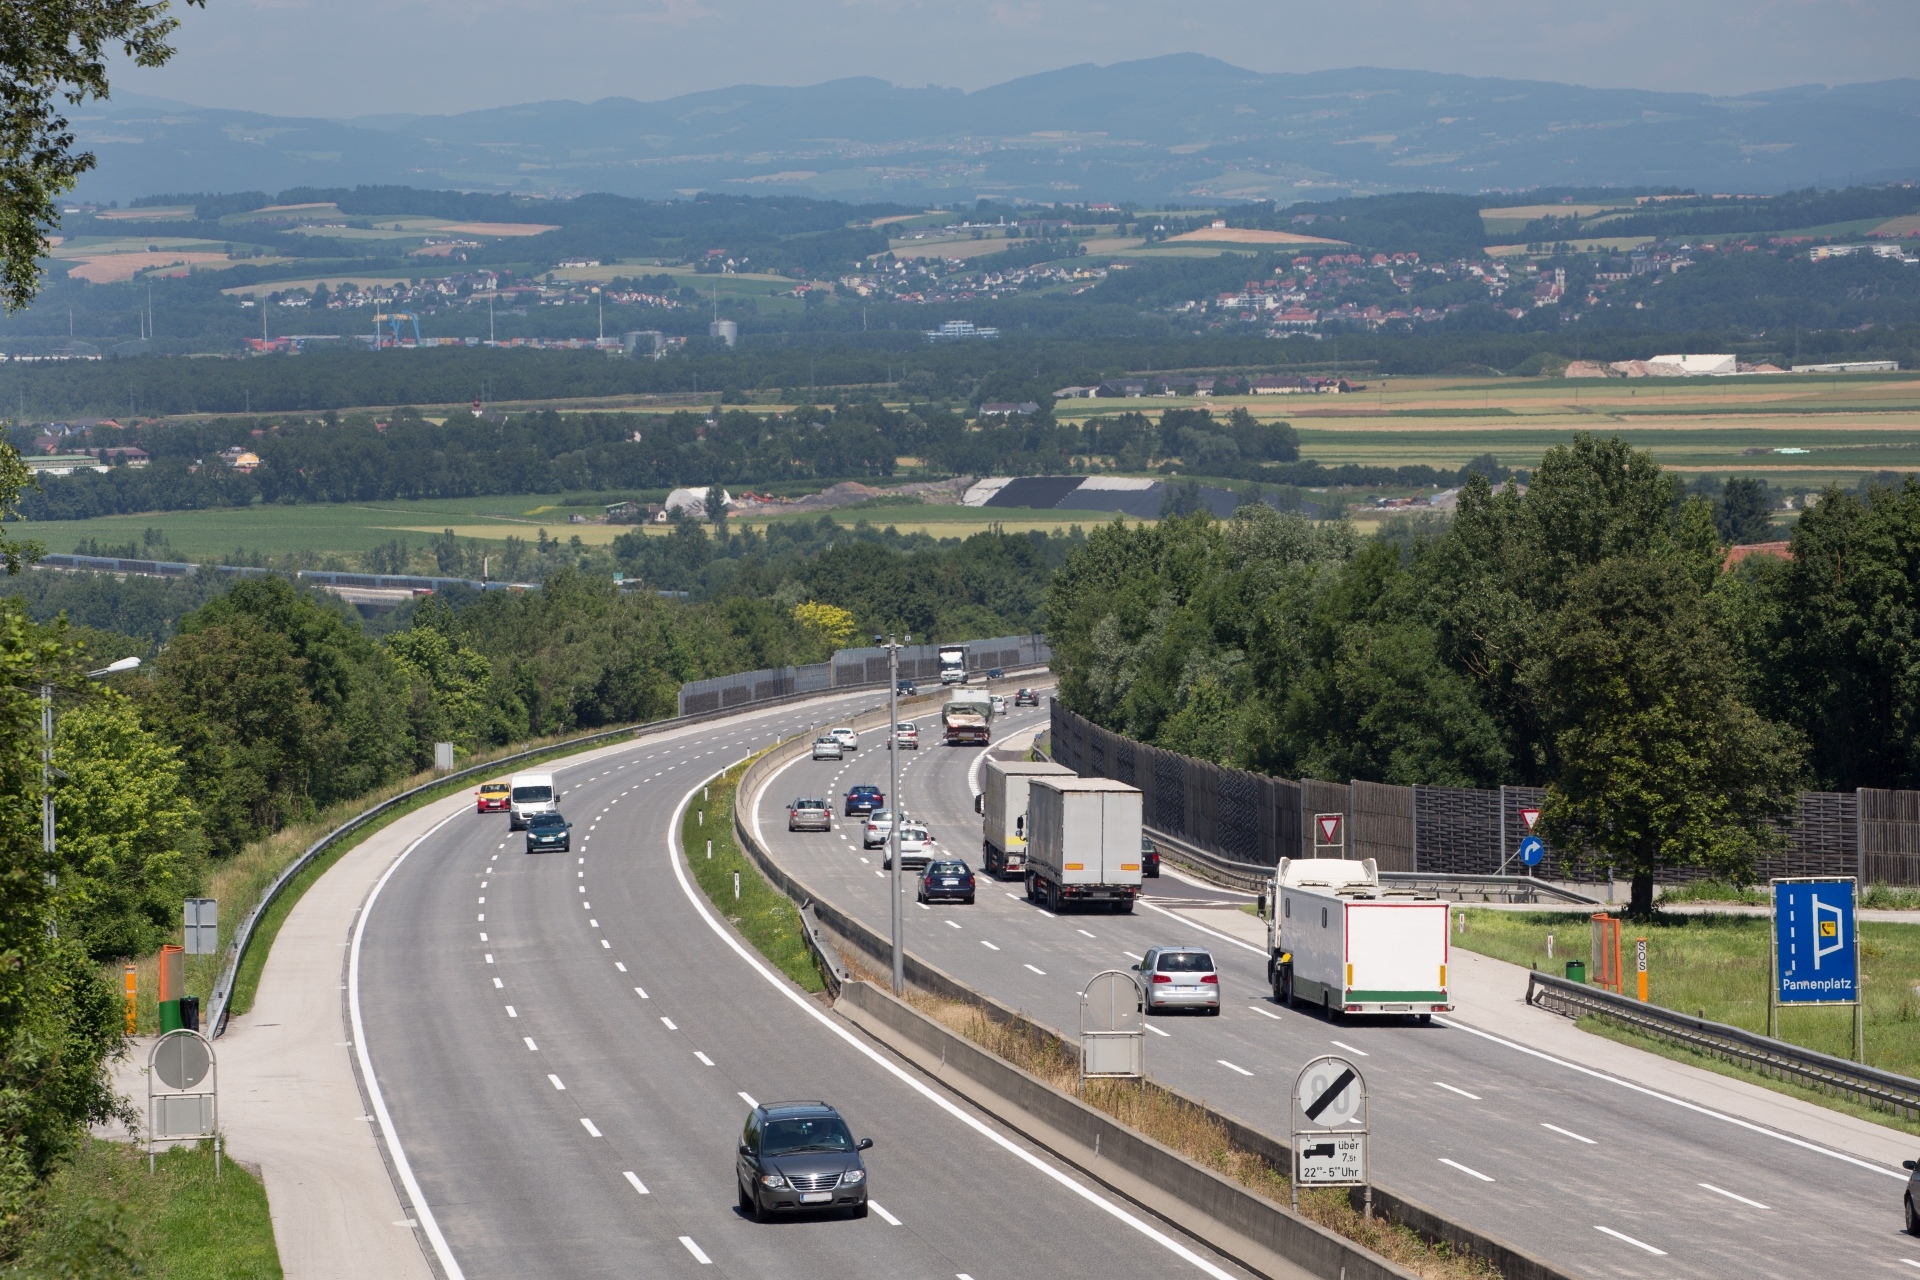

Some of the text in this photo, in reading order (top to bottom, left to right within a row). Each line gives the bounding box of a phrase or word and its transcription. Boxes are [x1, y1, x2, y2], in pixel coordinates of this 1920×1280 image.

[1638, 941, 1646, 971] SOS
[1783, 978, 1852, 992] Pannenplatz
[1338, 1140, 1360, 1150] über
[1341, 1167, 1359, 1177] Uhr
